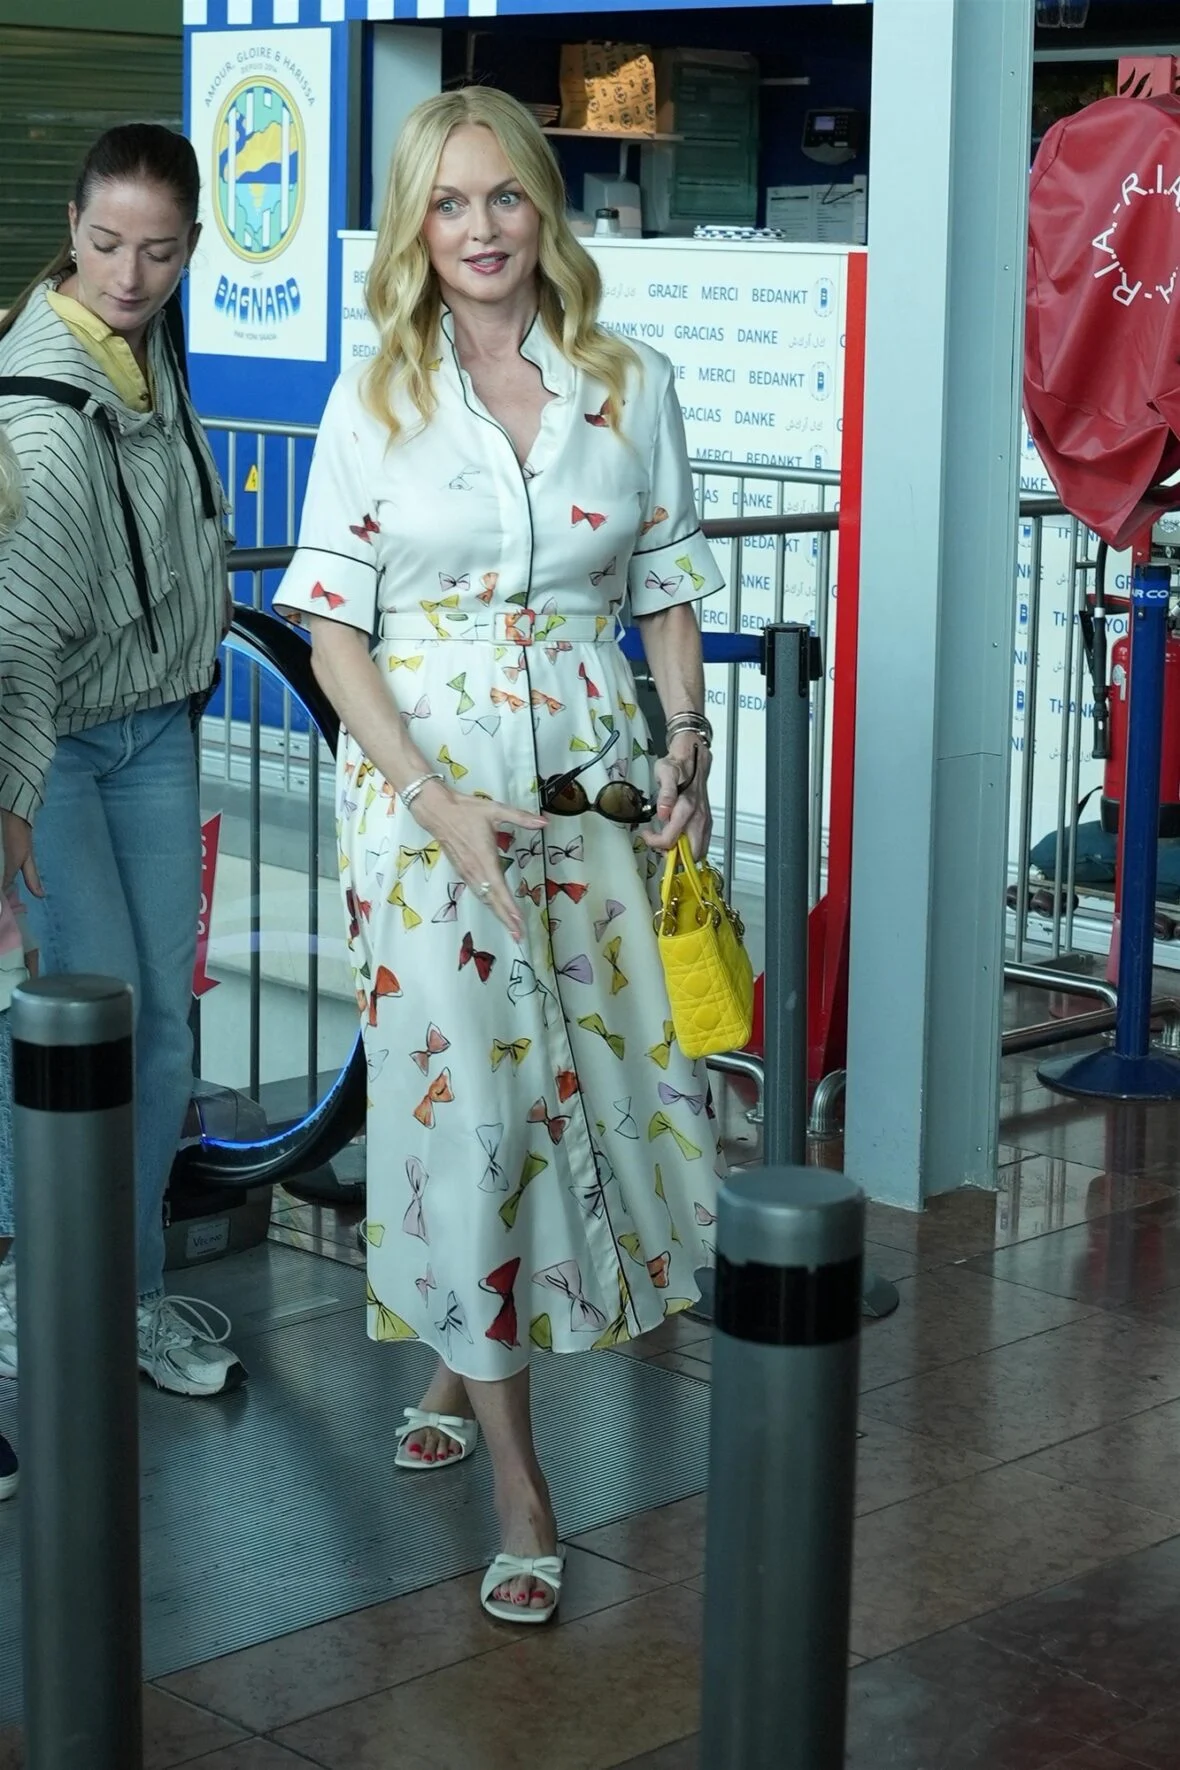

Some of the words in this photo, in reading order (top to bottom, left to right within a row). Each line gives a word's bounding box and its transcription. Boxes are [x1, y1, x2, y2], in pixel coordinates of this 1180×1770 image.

[236, 46, 272, 64] GLOIRE
[283, 56, 316, 107] HARISSA
[214, 274, 301, 324] BAGNARD
[648, 283, 688, 299] GRAZIE
[701, 285, 738, 301] MERCI
[751, 287, 808, 305] BEDANKT
[640, 323, 664, 338] YOU
[674, 325, 724, 341] GRACIAS
[737, 328, 778, 345] DANKE
[698, 366, 735, 383] MERCI
[748, 369, 805, 388] BEDANKT
[680, 406, 722, 423] RACIAS
[734, 410, 775, 427] DANKE
[746, 452, 802, 468] BEDANKT
